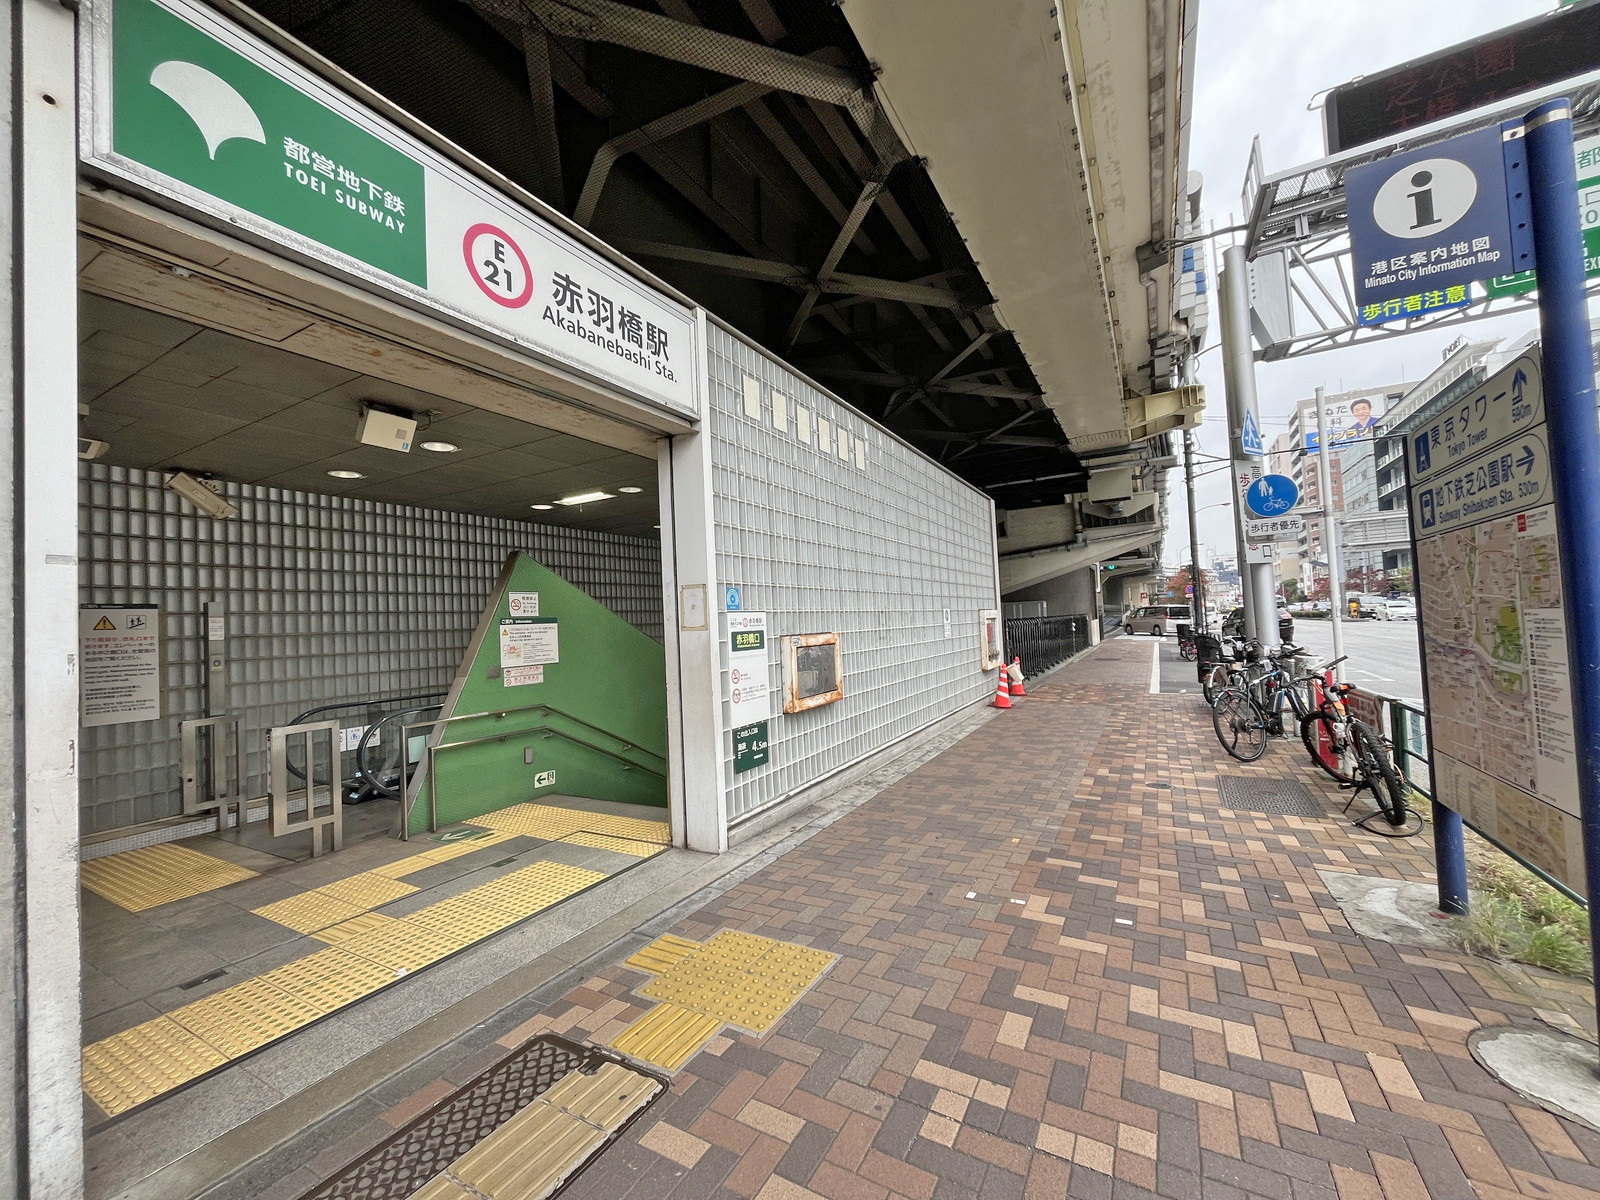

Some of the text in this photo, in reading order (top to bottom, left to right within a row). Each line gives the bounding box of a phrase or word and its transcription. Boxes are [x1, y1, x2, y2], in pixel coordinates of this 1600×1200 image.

[283, 136, 406, 217] 都営地下鉄
[283, 161, 406, 235] TOEI SUBWAY
[494, 239, 505, 264] E
[1364, 251, 1501, 289] Minato City Information Map
[1371, 236, 1490, 276] 港区案内地図
[483, 259, 513, 293] 21
[552, 270, 670, 362] 赤羽橋駅
[1363, 285, 1466, 321] 歩行者注意
[542, 305, 678, 383] Akabanebashi Sta.
[1430, 391, 1507, 450] 東京タワー
[1447, 428, 1488, 458] Tokyo Tower
[1435, 452, 1515, 508] 地下鉄芝公園駅
[1439, 506, 1461, 524] Subway
[1463, 495, 1498, 517] Shibakoen
[1500, 488, 1514, 504] Sta.
[1250, 519, 1300, 534] 歩行者優先
